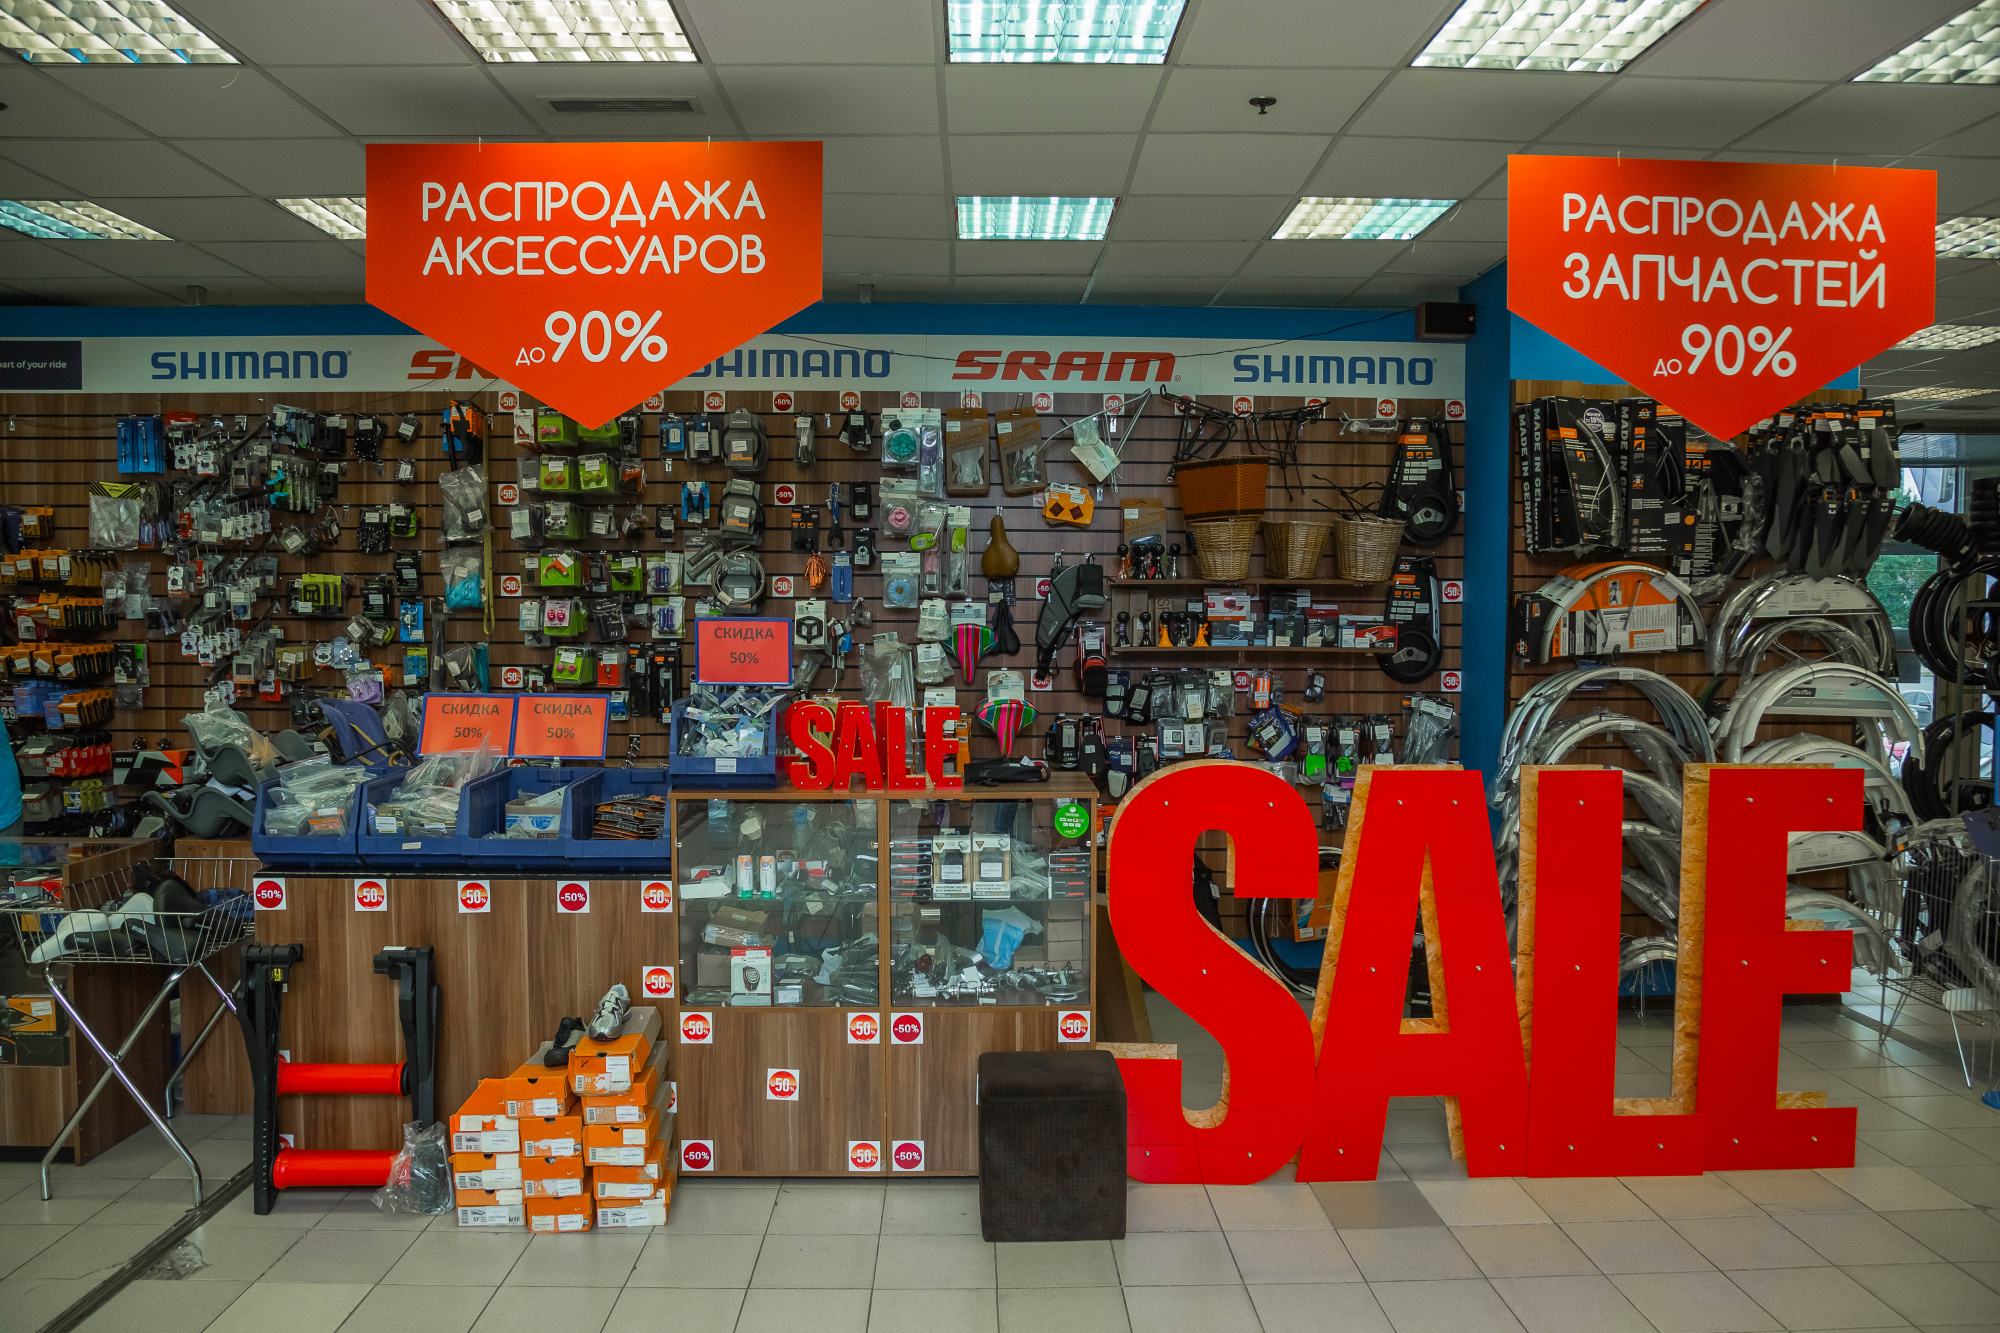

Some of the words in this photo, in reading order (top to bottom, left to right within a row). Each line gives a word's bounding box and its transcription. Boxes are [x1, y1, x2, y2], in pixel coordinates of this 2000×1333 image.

[422, 180, 766, 228] РАСПРОДАЖА
[1563, 193, 1886, 246] РАСПРОДАЖА
[422, 234, 766, 276] АКСЕССУАРОВ
[1563, 249, 1886, 309] ЗАПЧАСТЕЙ
[544, 310, 668, 363] 90%
[1681, 324, 1797, 378] 90%
[16, 361, 27, 369] of
[28, 362, 48, 370] your
[50, 361, 67, 369] ride
[151, 350, 348, 380] SHIMANO
[952, 350, 1176, 382] SRAM
[1233, 354, 1434, 386] SHIMANO
[1519, 414, 1529, 457] MADE
[1620, 406, 1628, 450] MADE
[1522, 461, 1530, 477] IN
[1534, 458, 1541, 473] IN
[1620, 454, 1628, 471] IN
[1524, 482, 1534, 555] GERMANY
[714, 627, 774, 640] СКИДКА
[730, 652, 759, 664] 50%
[441, 702, 500, 717] СКИДКА
[534, 702, 592, 717] СКИДКА
[453, 726, 482, 738] 50%
[546, 727, 575, 740] 50%
[790, 705, 962, 790] SALE
[256, 890, 282, 899] -50%
[560, 892, 586, 902] -50%
[1109, 759, 1866, 1185] SALE
[894, 1024, 920, 1034] -50%
[684, 1152, 710, 1162] -50%
[896, 1152, 921, 1162] -50%
